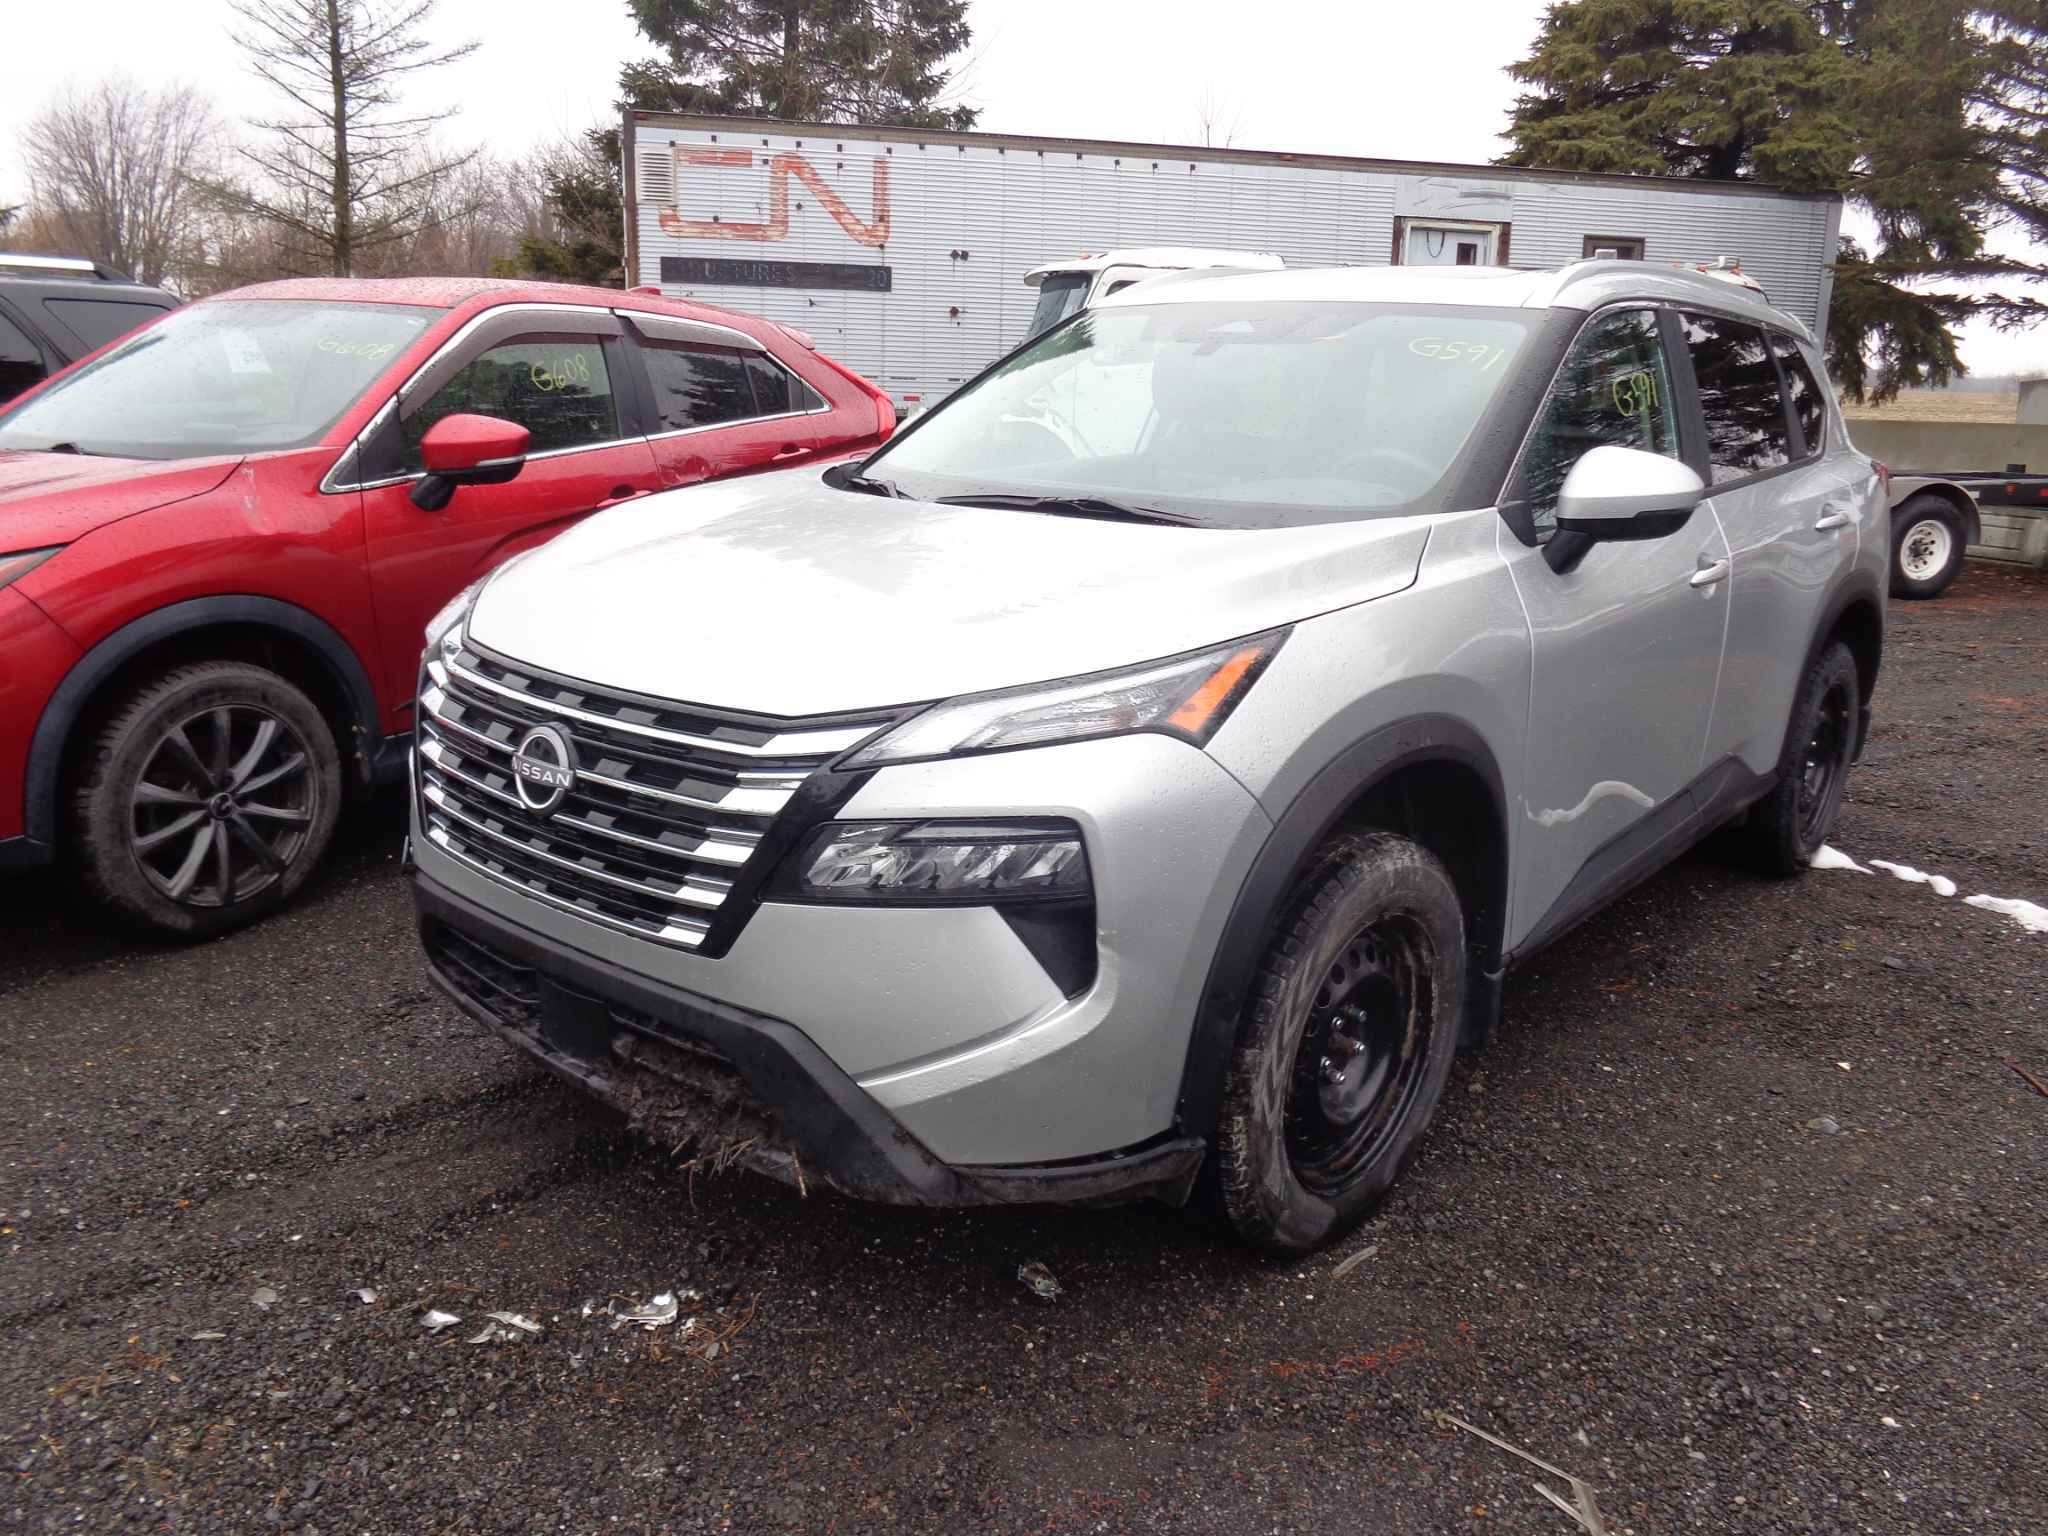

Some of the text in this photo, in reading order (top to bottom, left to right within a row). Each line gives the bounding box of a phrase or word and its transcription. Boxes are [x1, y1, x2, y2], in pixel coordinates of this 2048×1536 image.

[659, 146, 891, 247] CN
[531, 353, 591, 391] G608
[1408, 336, 1505, 372] G591
[511, 755, 570, 787] NISSAN
